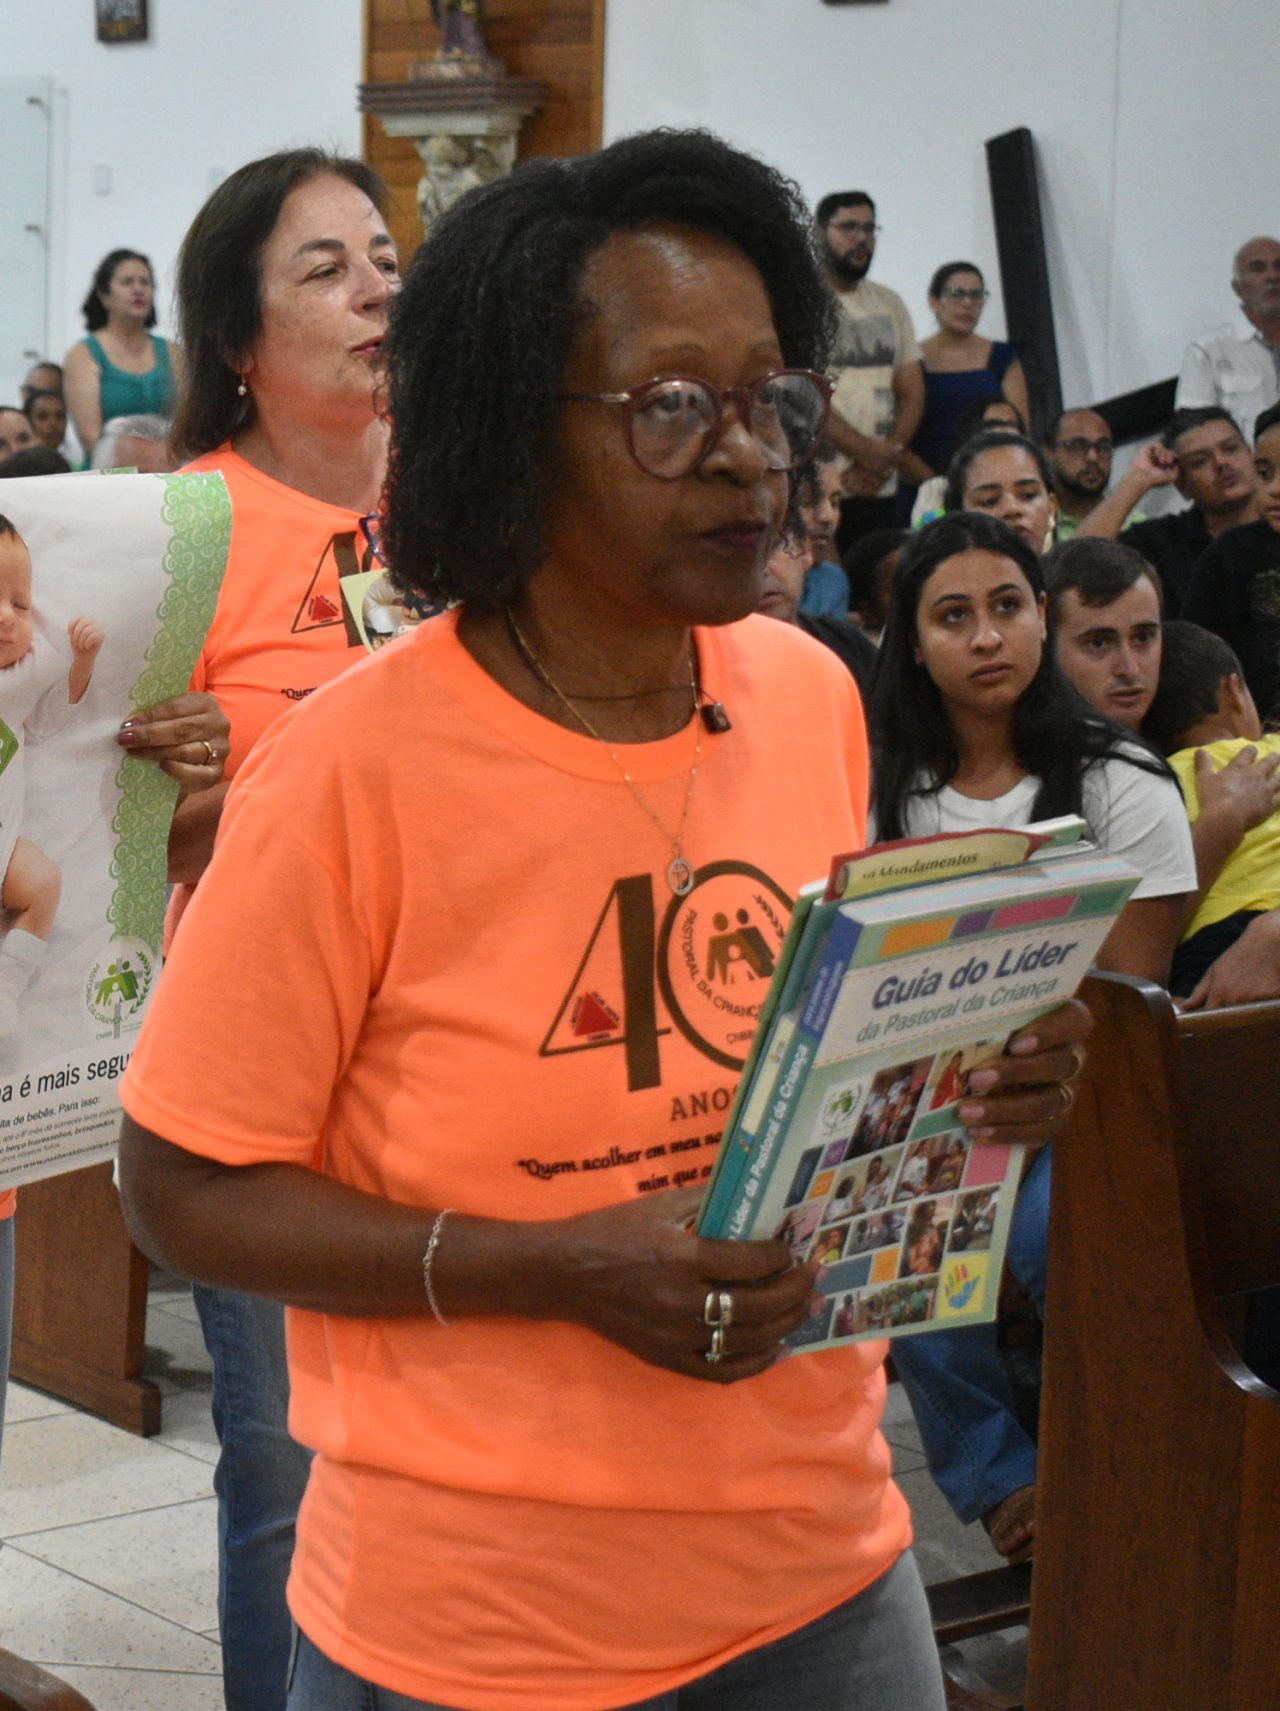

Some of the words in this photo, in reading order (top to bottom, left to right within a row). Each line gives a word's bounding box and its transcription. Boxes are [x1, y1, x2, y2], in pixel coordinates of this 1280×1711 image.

[879, 852, 979, 879] Mandamentos
[681, 907, 699, 981] PASTORAL
[697, 979, 714, 999] DA
[713, 996, 762, 1020] CRIANÇ
[872, 967, 943, 1011] Guia
[948, 957, 989, 988] do
[993, 939, 1079, 980] Líder
[855, 1021, 880, 1043] da
[882, 1001, 962, 1036] Pastoral
[962, 992, 985, 1014] da
[989, 977, 1059, 1007] Criança
[19, 1074, 31, 1099] é
[37, 1063, 80, 1095] mais
[86, 1052, 132, 1081] segu
[779, 1044, 811, 1099] Criança
[12, 1115, 25, 1125] de
[58, 1102, 79, 1114] Para
[671, 1084, 739, 1121] ANO
[773, 1100, 789, 1119] da
[582, 1145, 642, 1171] acolher
[645, 1144, 666, 1160] em
[671, 1135, 701, 1154] meu
[750, 1117, 781, 1178] Pastoral
[637, 1173, 669, 1193] mim
[673, 1167, 698, 1187] que
[743, 1178, 760, 1197] da
